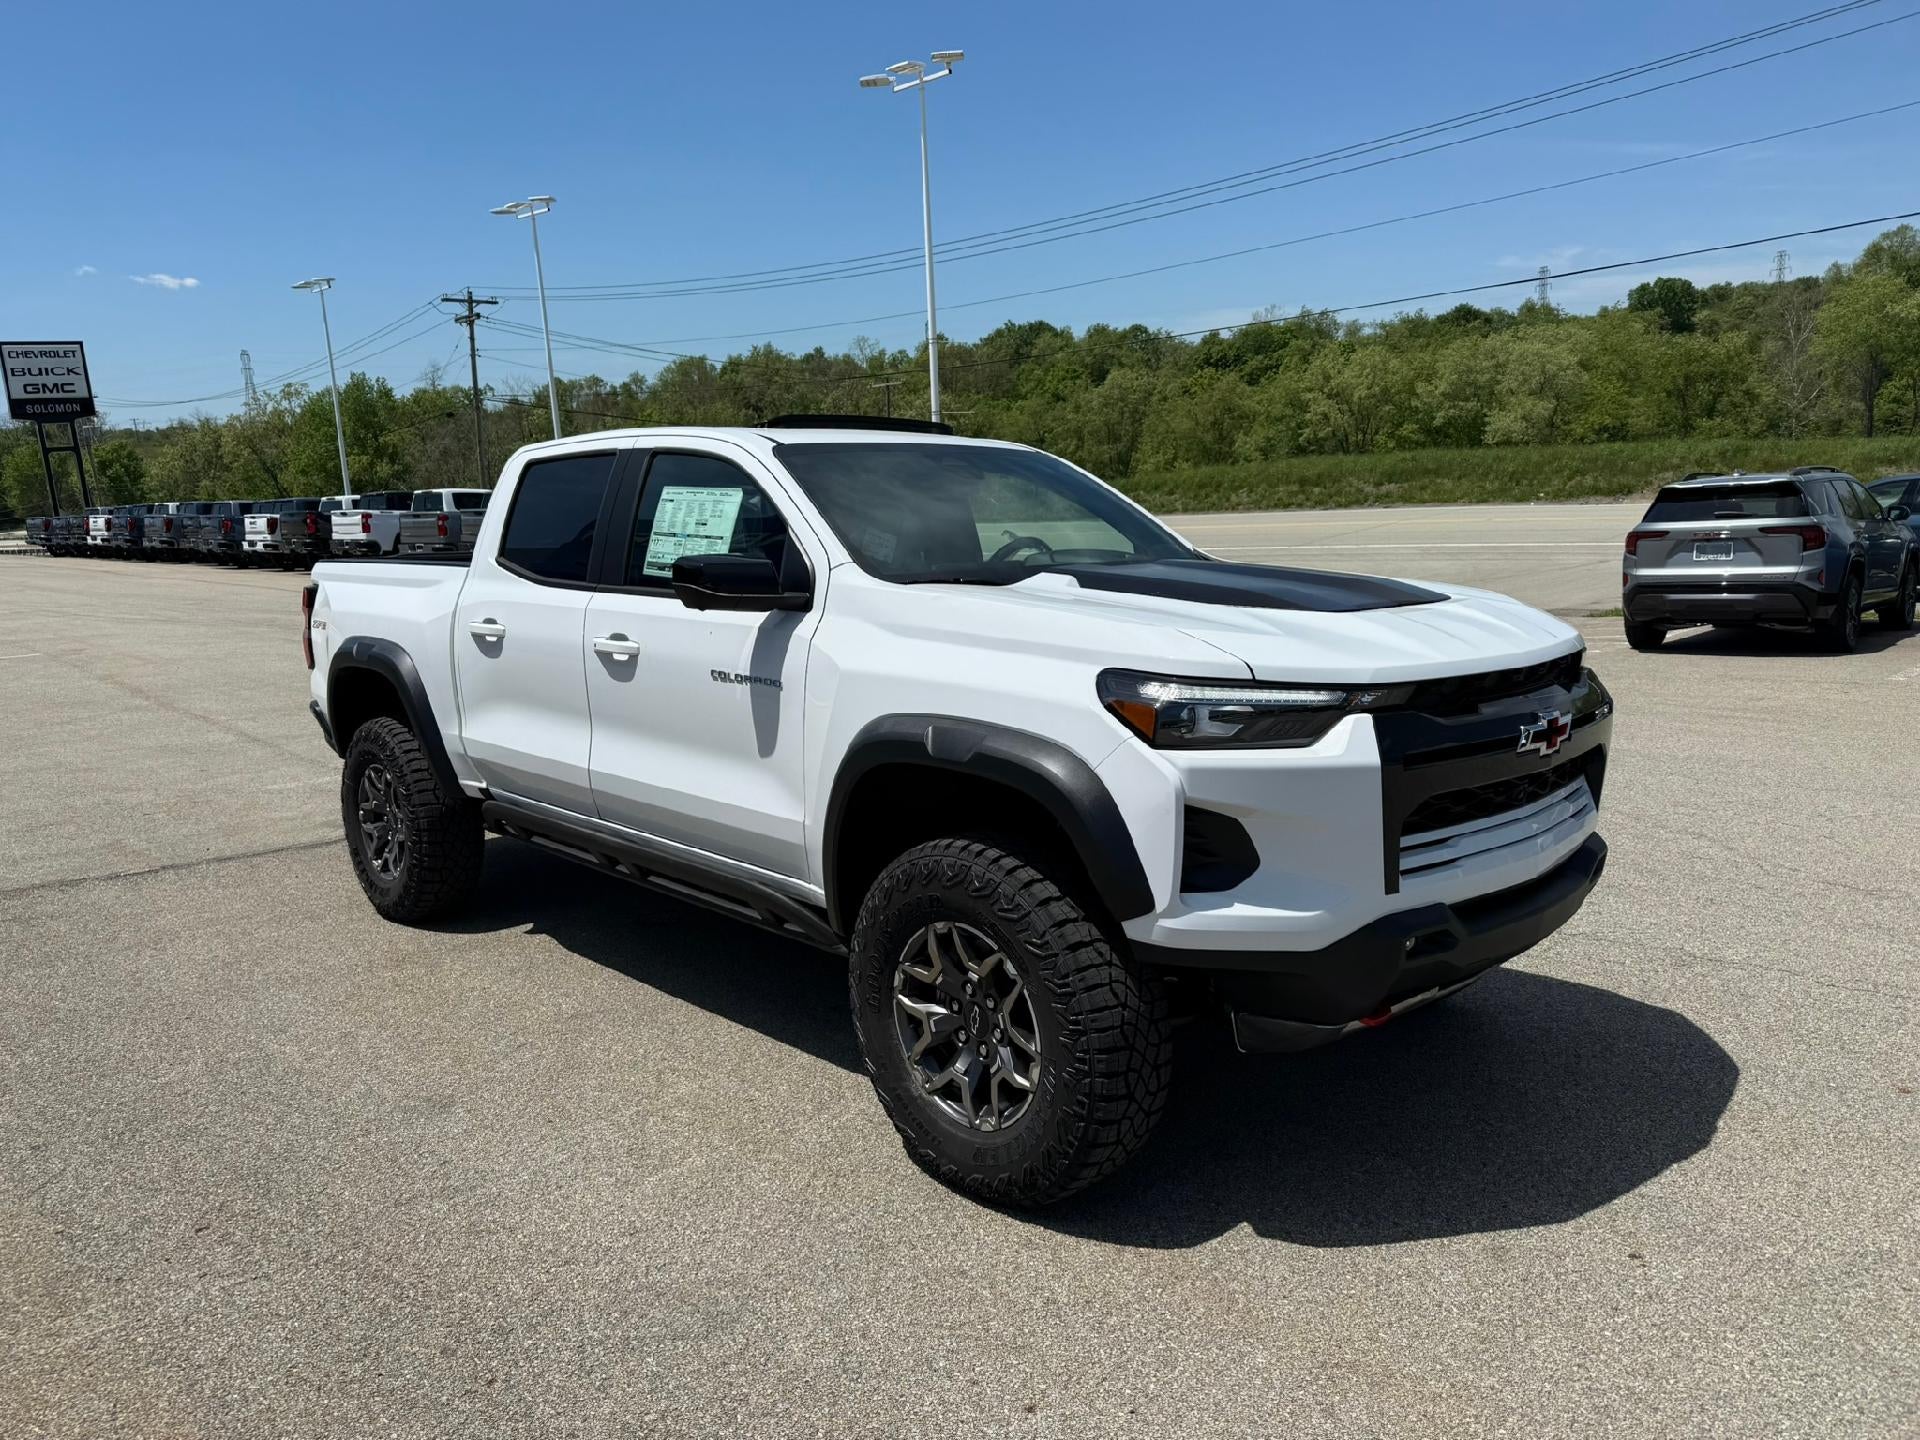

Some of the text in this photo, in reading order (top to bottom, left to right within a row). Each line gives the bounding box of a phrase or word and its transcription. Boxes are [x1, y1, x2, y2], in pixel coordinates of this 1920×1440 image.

[8, 350, 77, 358] CHEVROLET
[10, 366, 82, 377] BUICK
[23, 383, 76, 394] GMC
[25, 403, 80, 413] SOLOMON
[711, 669, 781, 688] COLORADO
